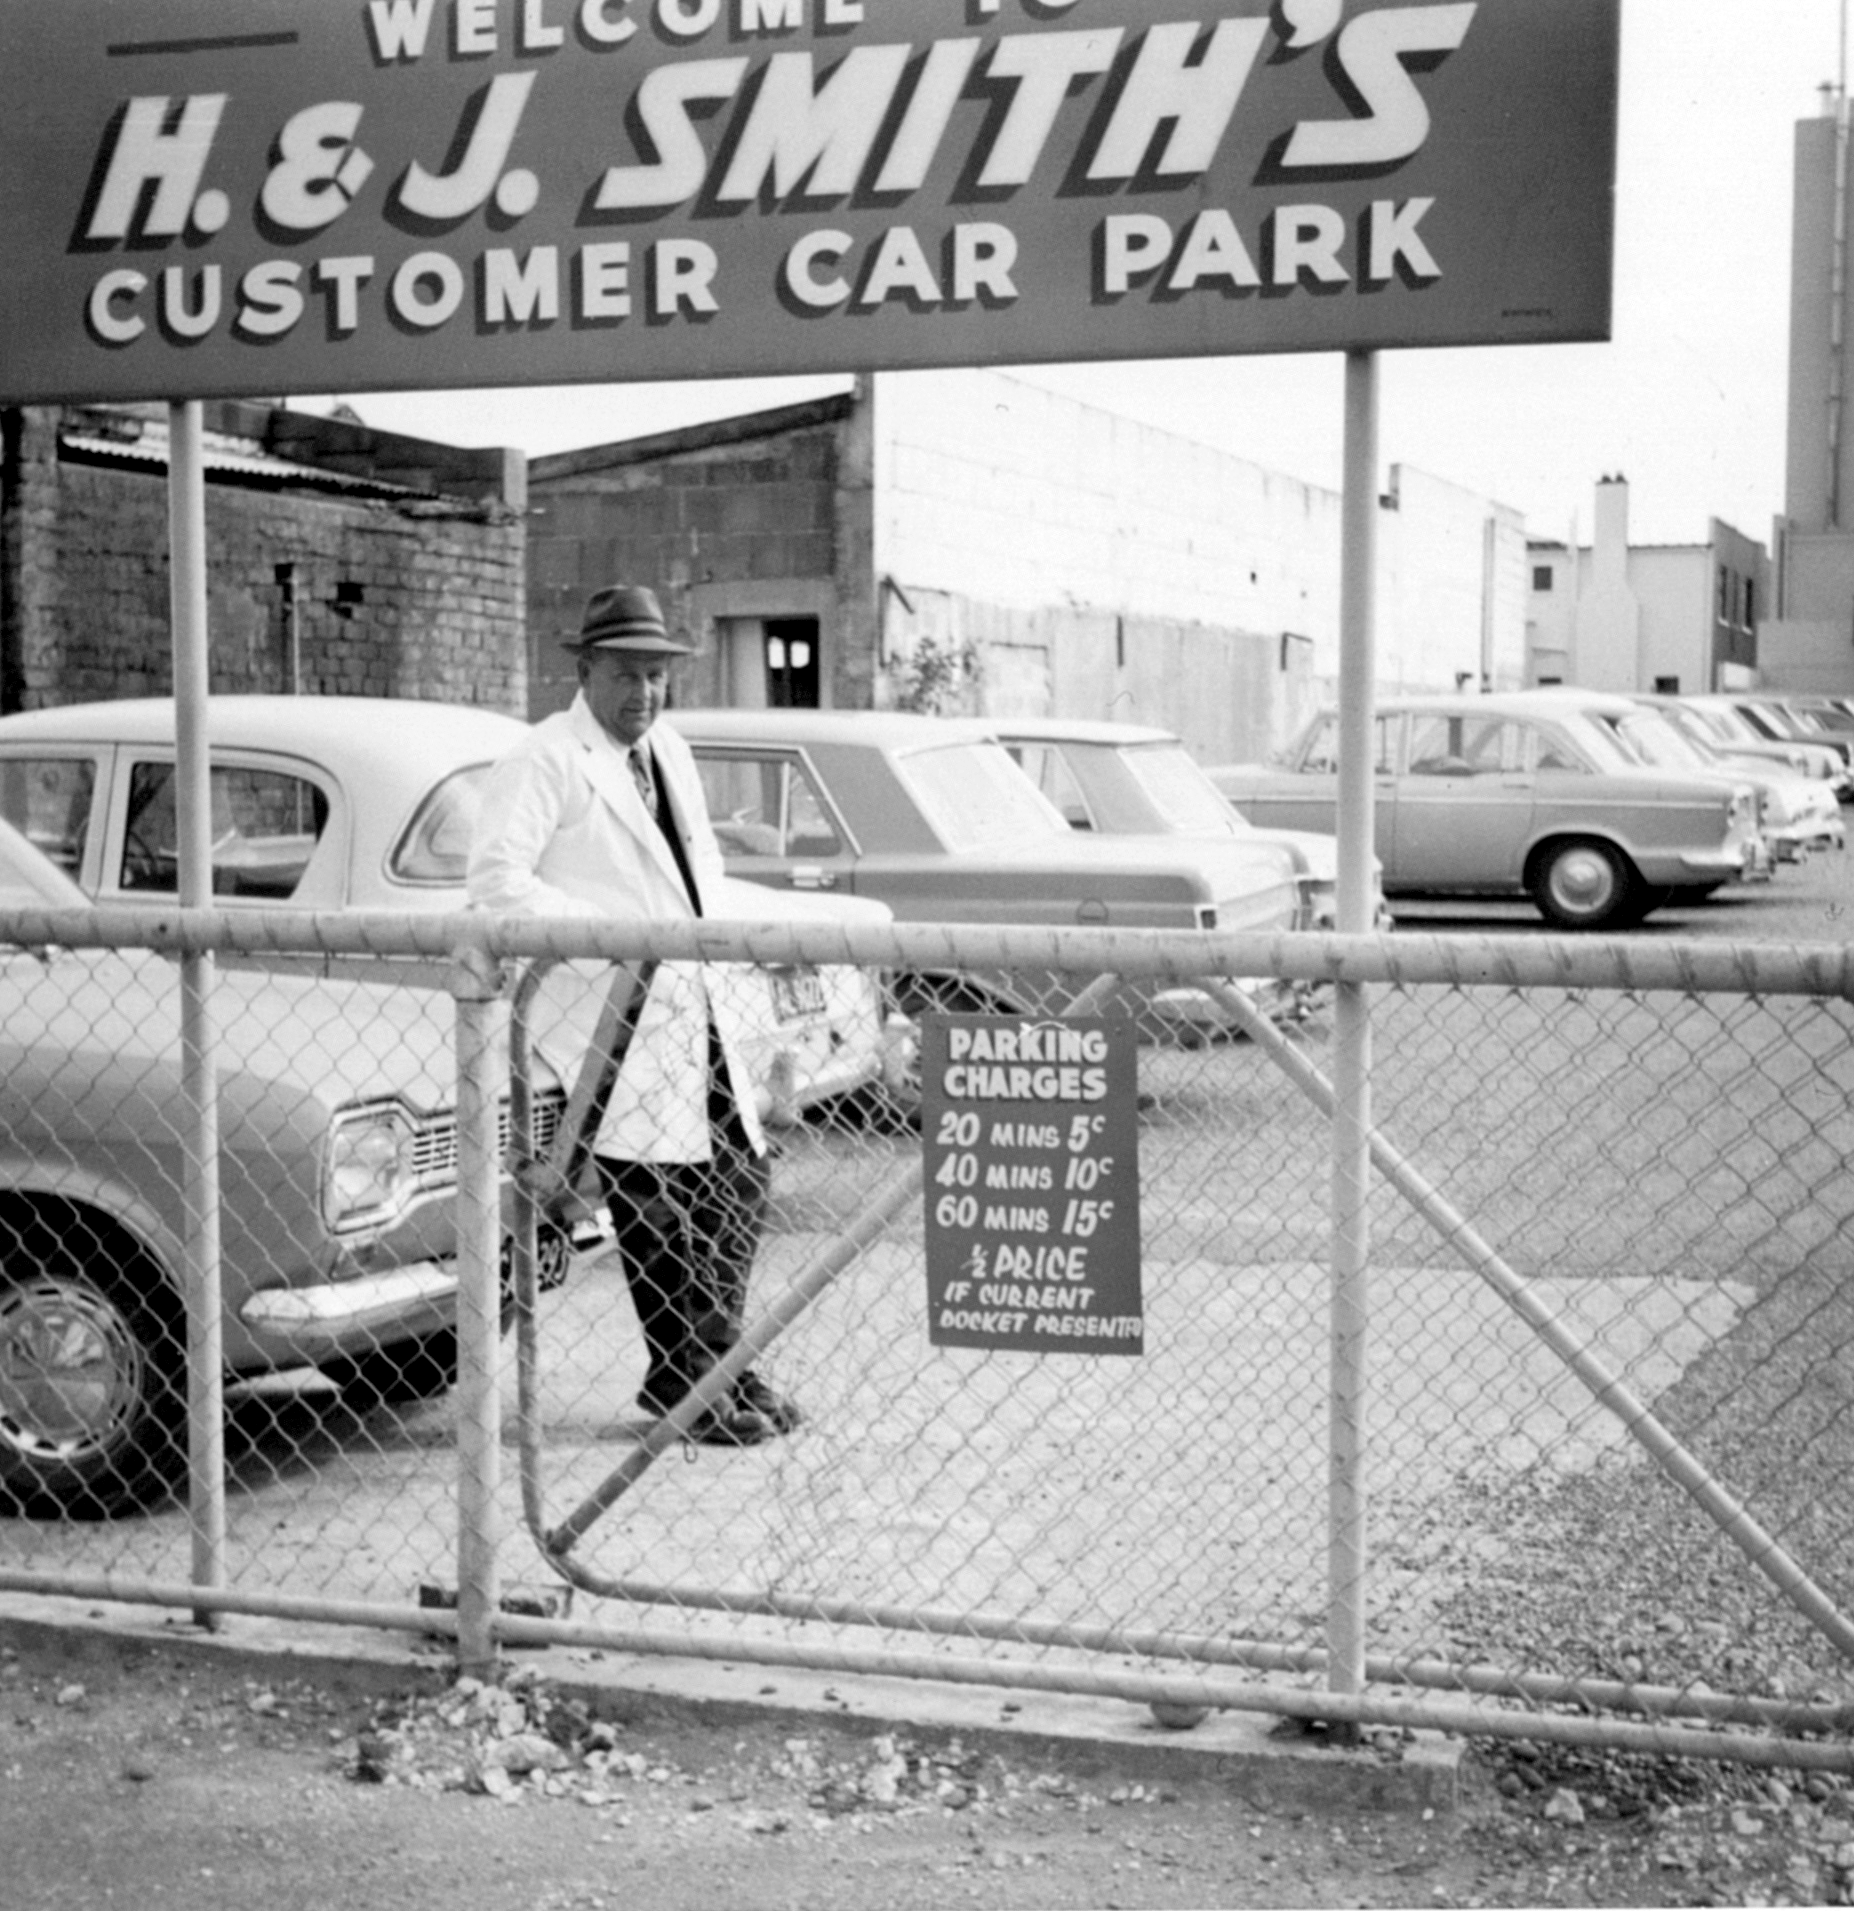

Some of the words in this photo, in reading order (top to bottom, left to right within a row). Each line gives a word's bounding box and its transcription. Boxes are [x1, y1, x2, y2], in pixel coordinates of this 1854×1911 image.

[86, 94, 230, 236] H.
[264, 102, 373, 227] &
[401, 70, 539, 217] J.
[595, 0, 1476, 208] SMITH'S
[91, 239, 719, 341] CUSTOMER
[787, 222, 1018, 305] CAR
[1106, 198, 1441, 291] PARK
[951, 1028, 1107, 1062] PARKING
[945, 1065, 1106, 1099] CHARGES
[936, 1110, 981, 1147] 20
[990, 1123, 1060, 1149] MINS
[935, 1152, 978, 1187] 40
[986, 1164, 1053, 1190] MINS
[936, 1194, 978, 1228] 60
[984, 1206, 1049, 1233] MINS
[993, 1244, 1088, 1281] PRICE
[944, 1281, 972, 1303] IF
[978, 1283, 1095, 1310] CURRENT
[939, 1309, 1028, 1333] DOCKET
